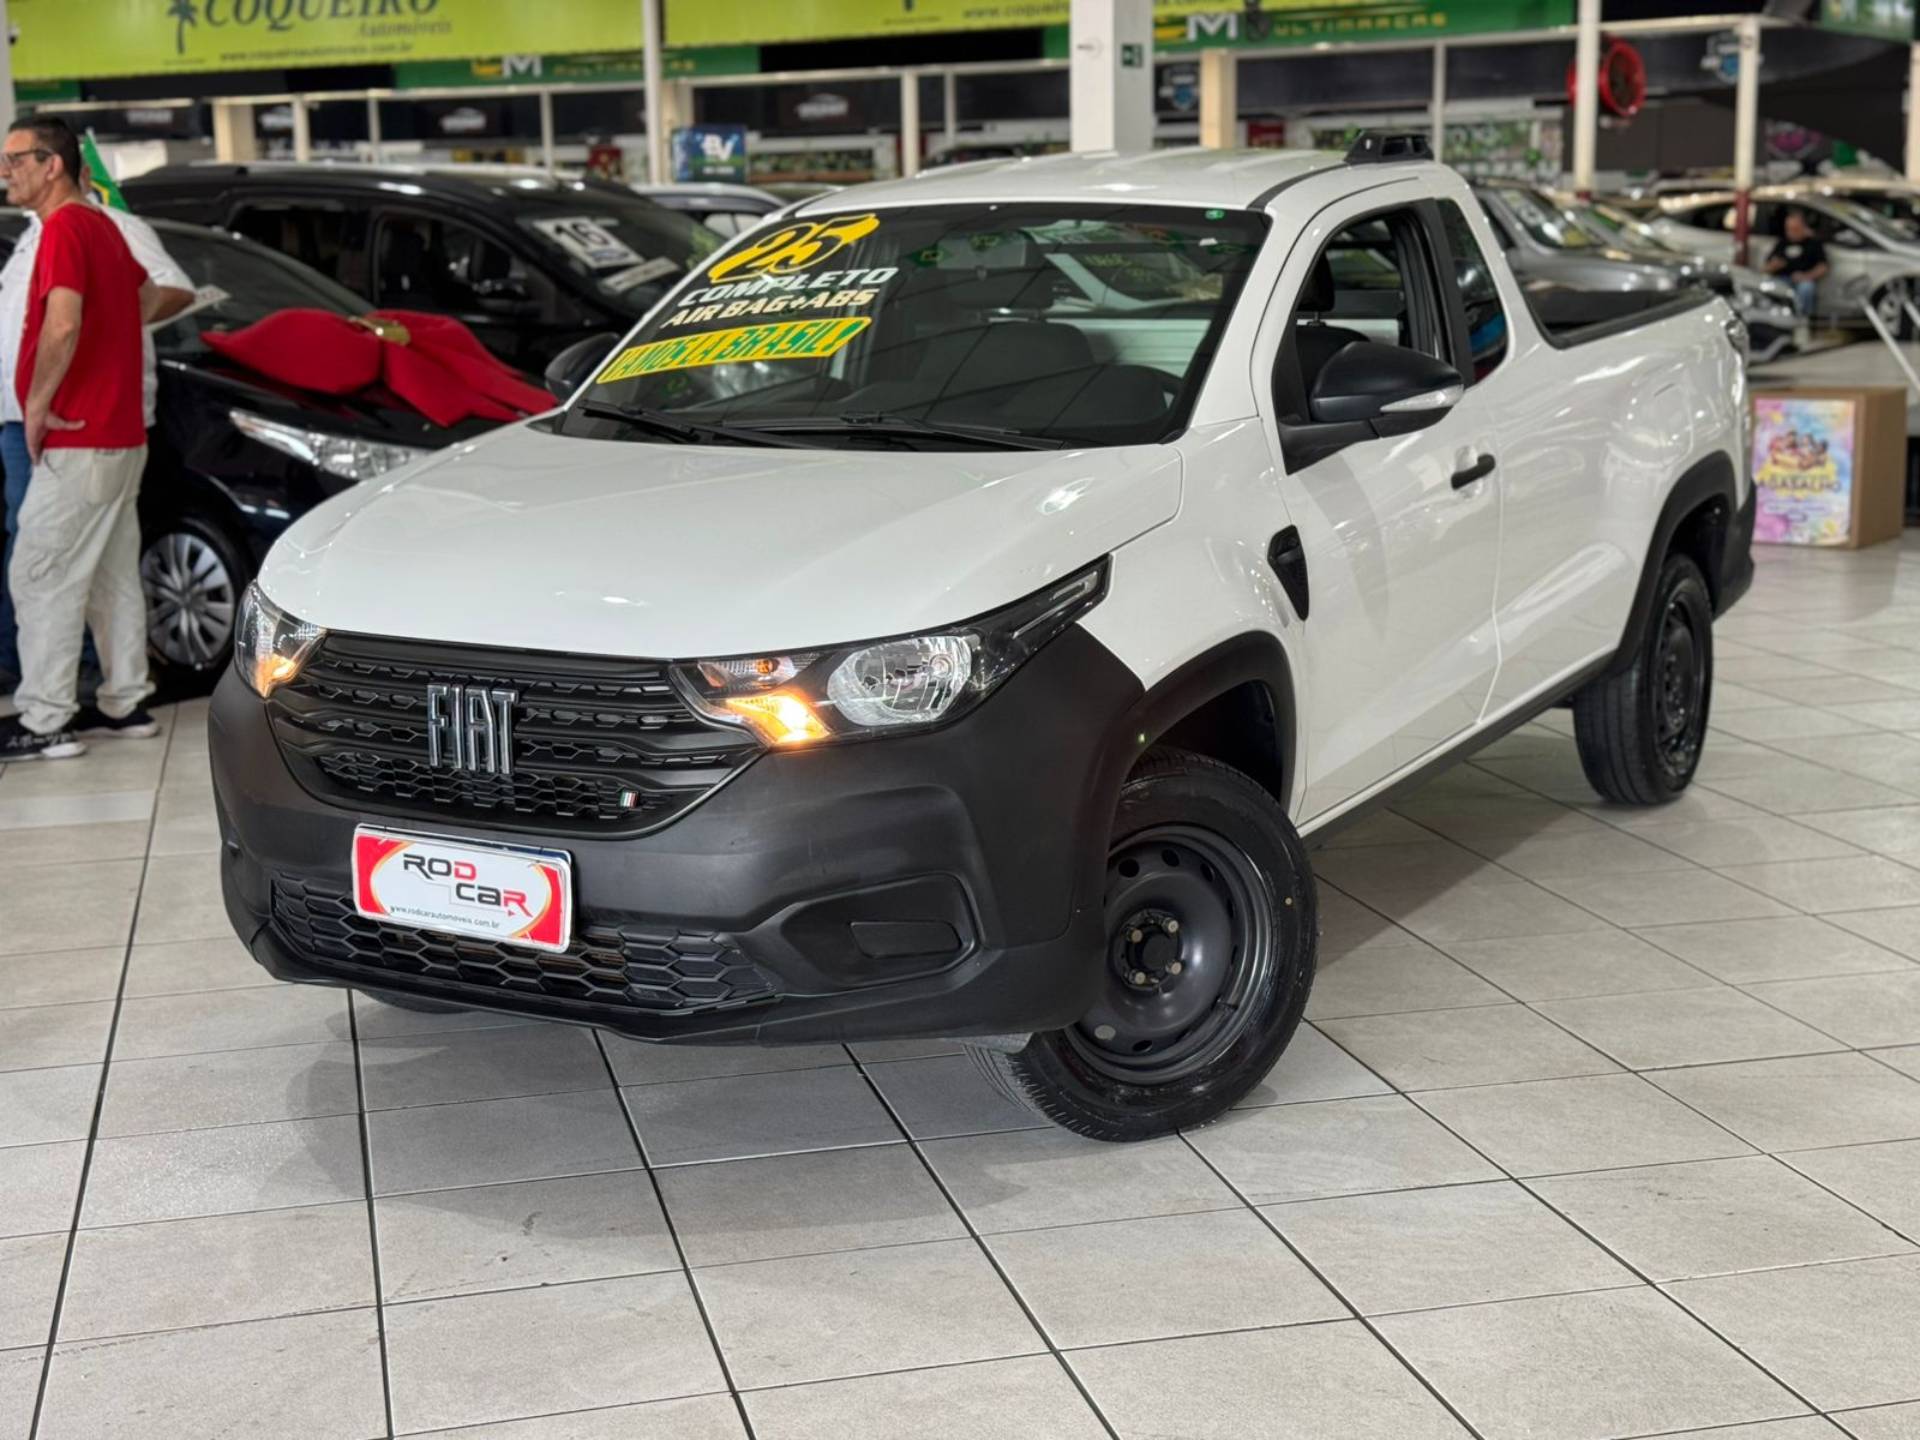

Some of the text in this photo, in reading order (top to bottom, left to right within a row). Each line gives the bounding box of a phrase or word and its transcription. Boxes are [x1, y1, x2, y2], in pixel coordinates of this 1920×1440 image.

[707, 212, 880, 283] 25
[677, 267, 899, 308] COMPLETO
[660, 302, 723, 329] AIR
[427, 684, 519, 776] FIAT
[403, 853, 477, 881] ROD
